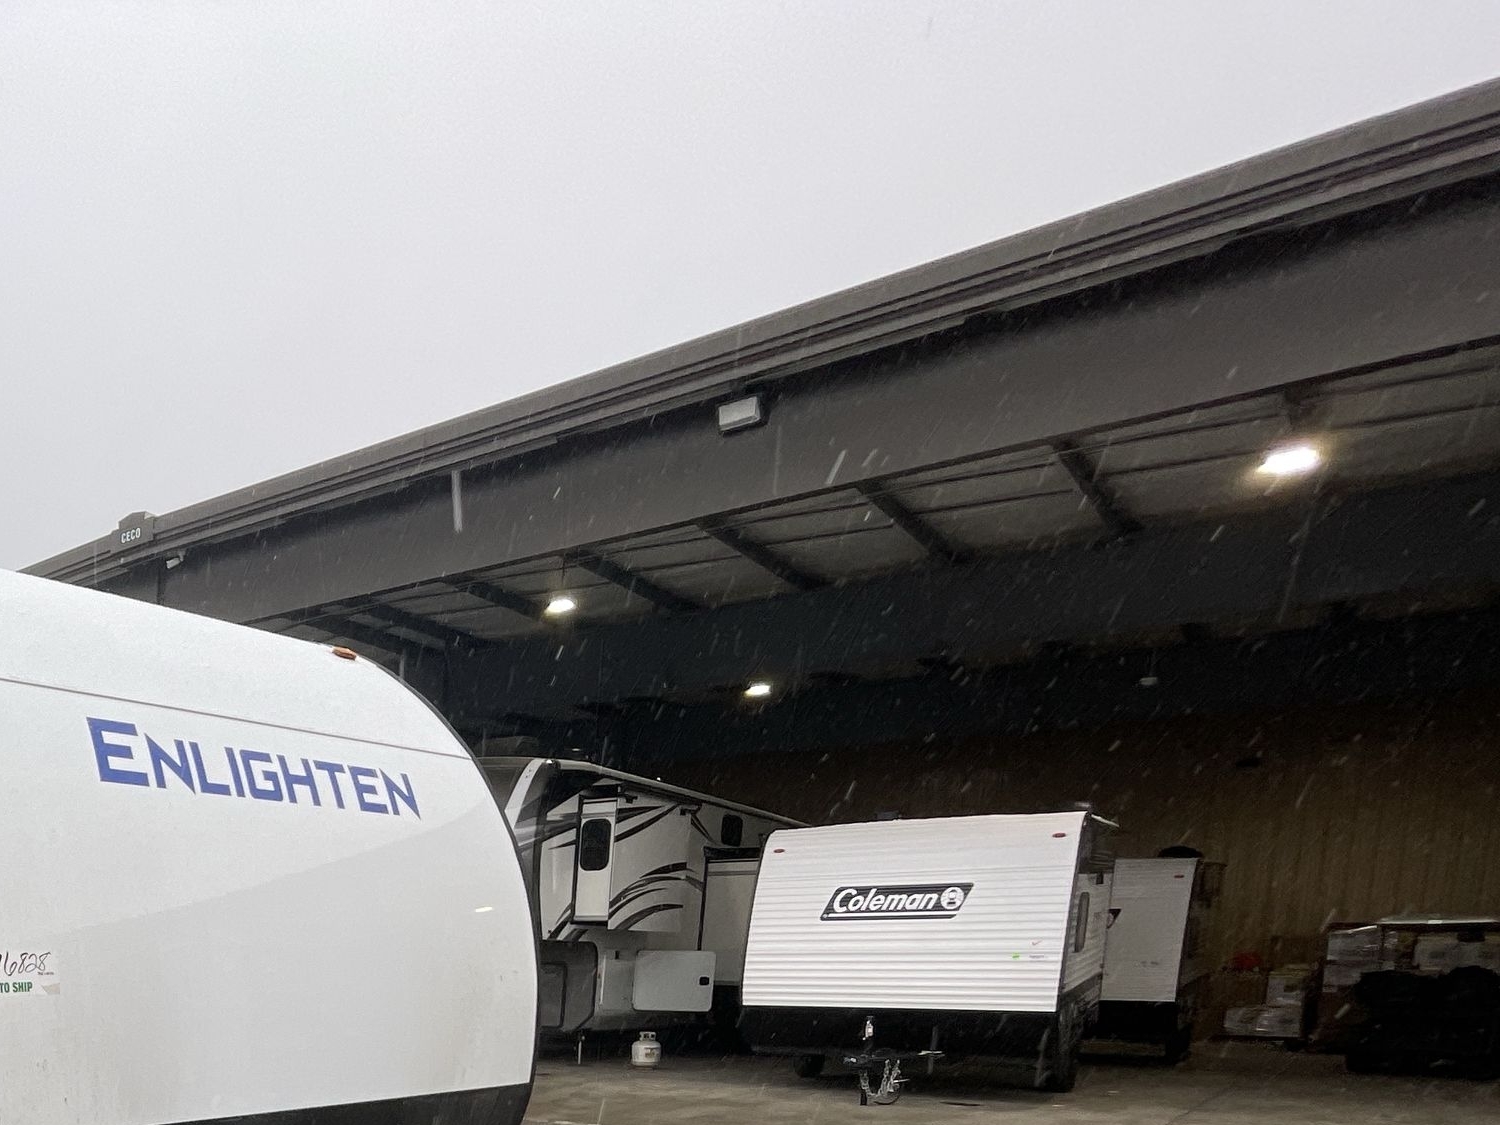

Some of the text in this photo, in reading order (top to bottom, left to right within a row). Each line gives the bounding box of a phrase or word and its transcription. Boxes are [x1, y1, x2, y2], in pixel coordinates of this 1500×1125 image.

[121, 527, 141, 544] CECO
[86, 717, 422, 820] ENLIGHTEN
[833, 888, 939, 913] Coleman
[0, 982, 10, 993] TO
[12, 981, 33, 993] SHIP
